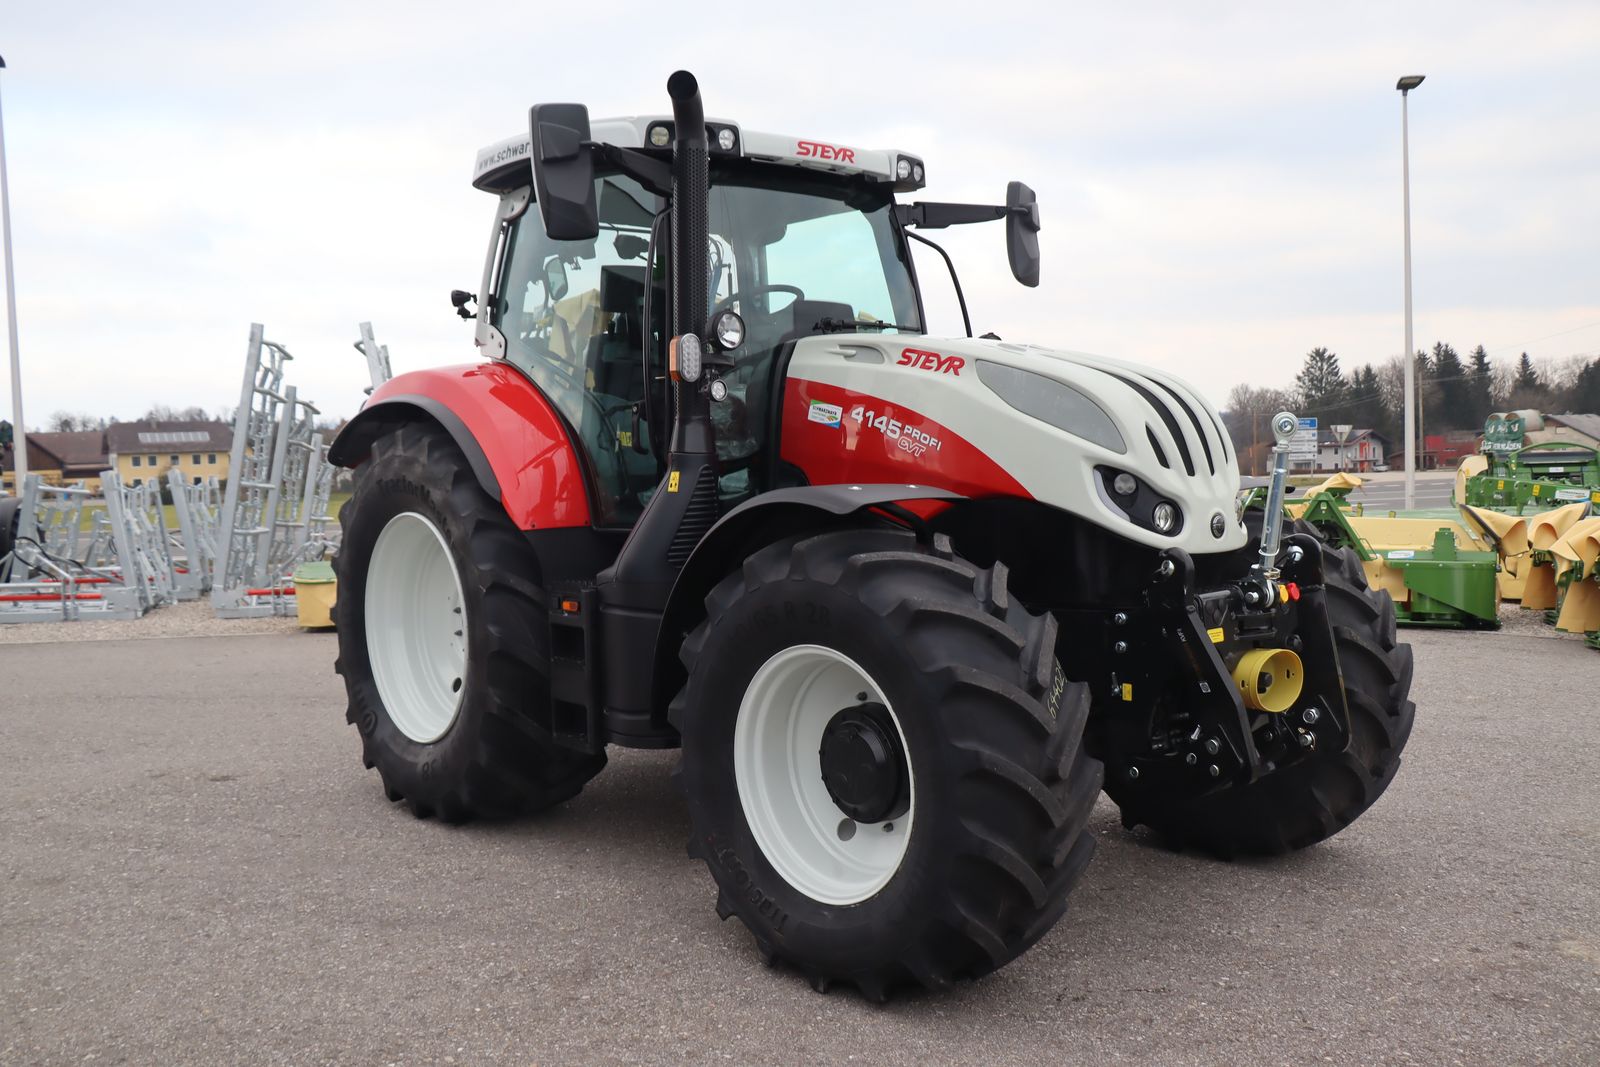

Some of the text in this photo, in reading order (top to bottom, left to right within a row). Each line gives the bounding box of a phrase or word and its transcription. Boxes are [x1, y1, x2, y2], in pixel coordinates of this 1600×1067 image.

[478, 142, 530, 170] www.schwar
[796, 141, 855, 164] STEYR
[896, 347, 966, 377] STEYR
[850, 406, 942, 452] 4145 PROFI
[897, 436, 926, 457] CVT
